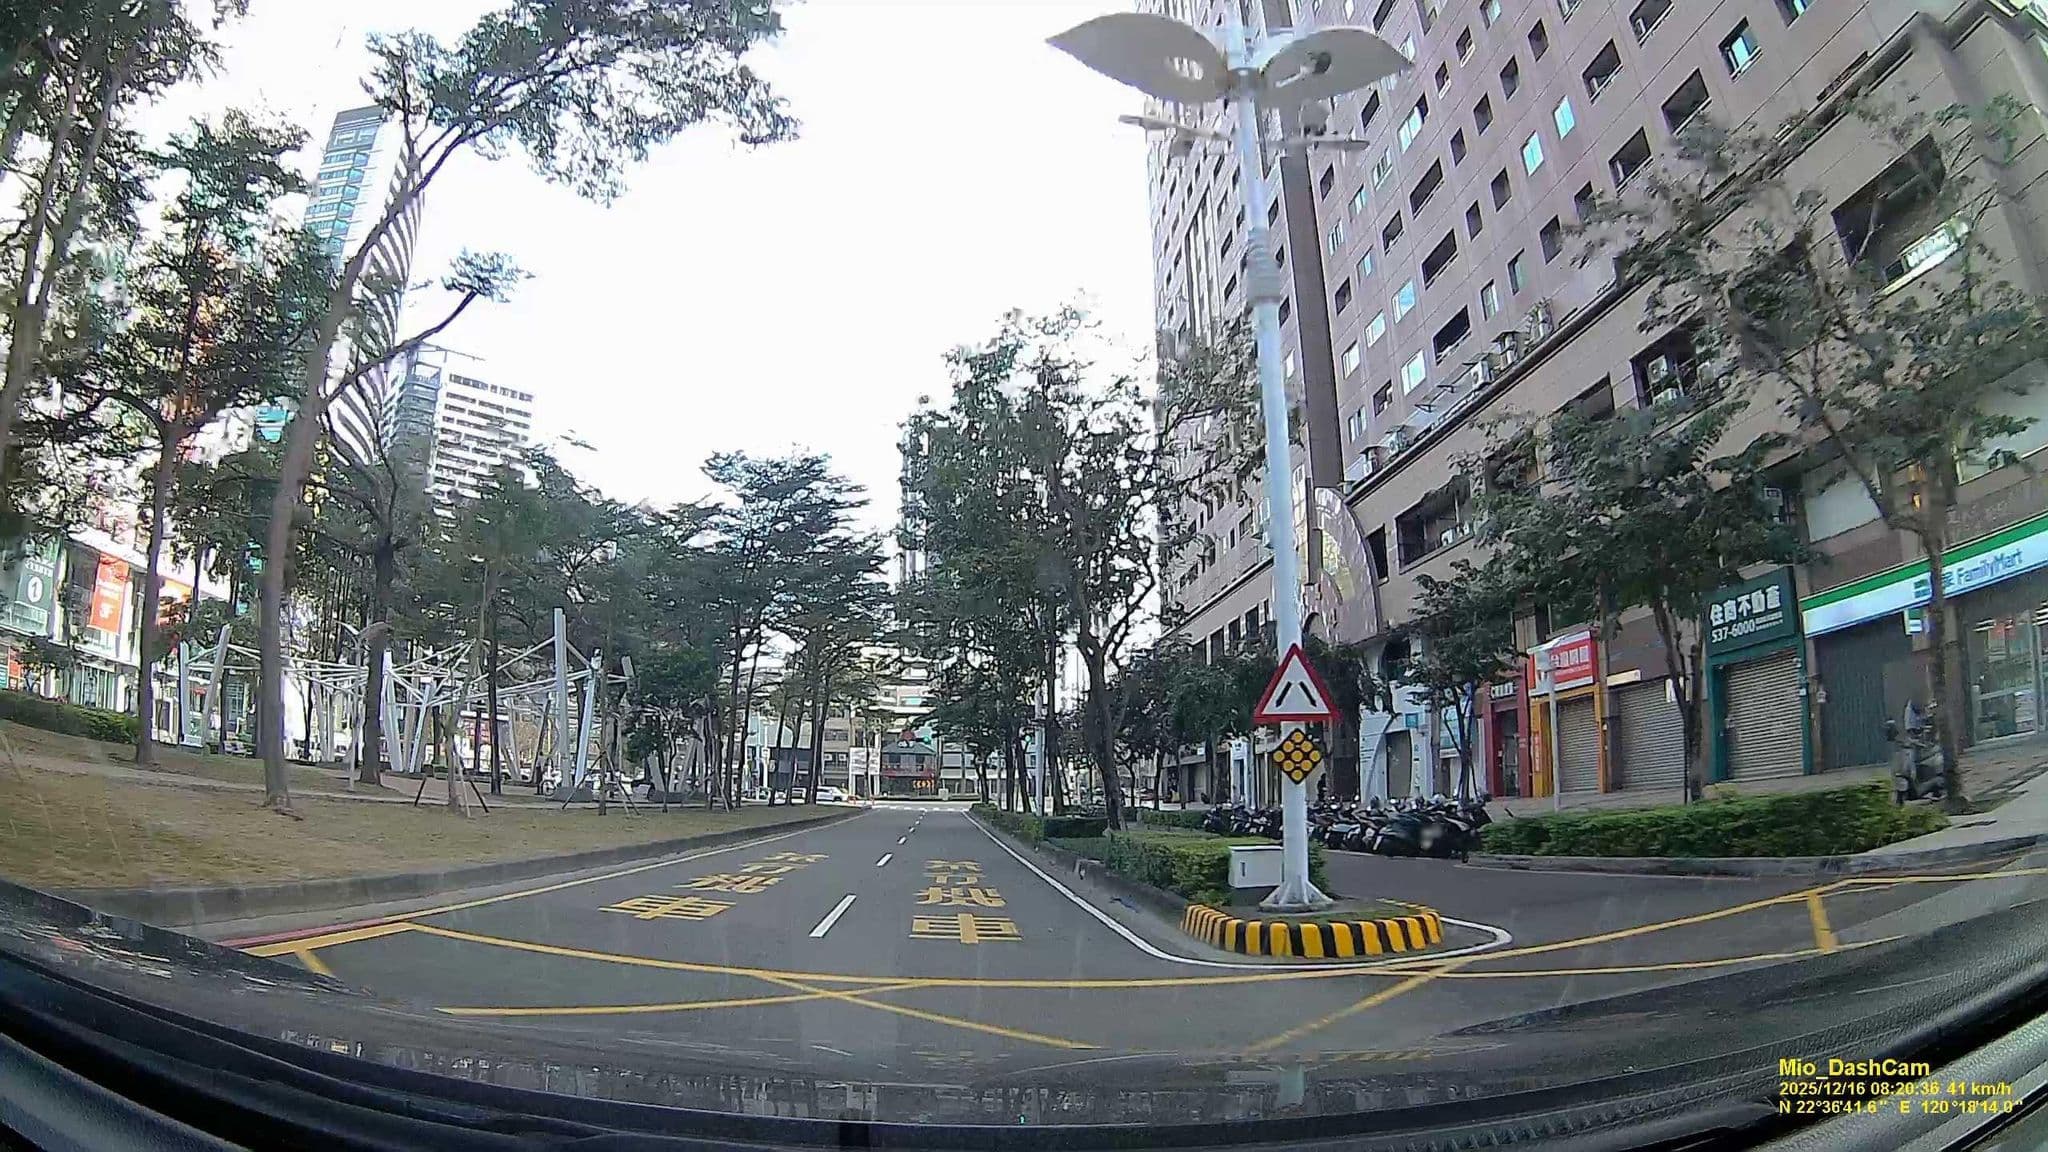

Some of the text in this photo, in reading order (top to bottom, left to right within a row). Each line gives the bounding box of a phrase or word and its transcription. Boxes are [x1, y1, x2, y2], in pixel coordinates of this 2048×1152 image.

[1957, 549, 2023, 585] FamilyMart
[1710, 584, 1781, 627] 住商不動產
[1711, 619, 1755, 643] 537-6000
